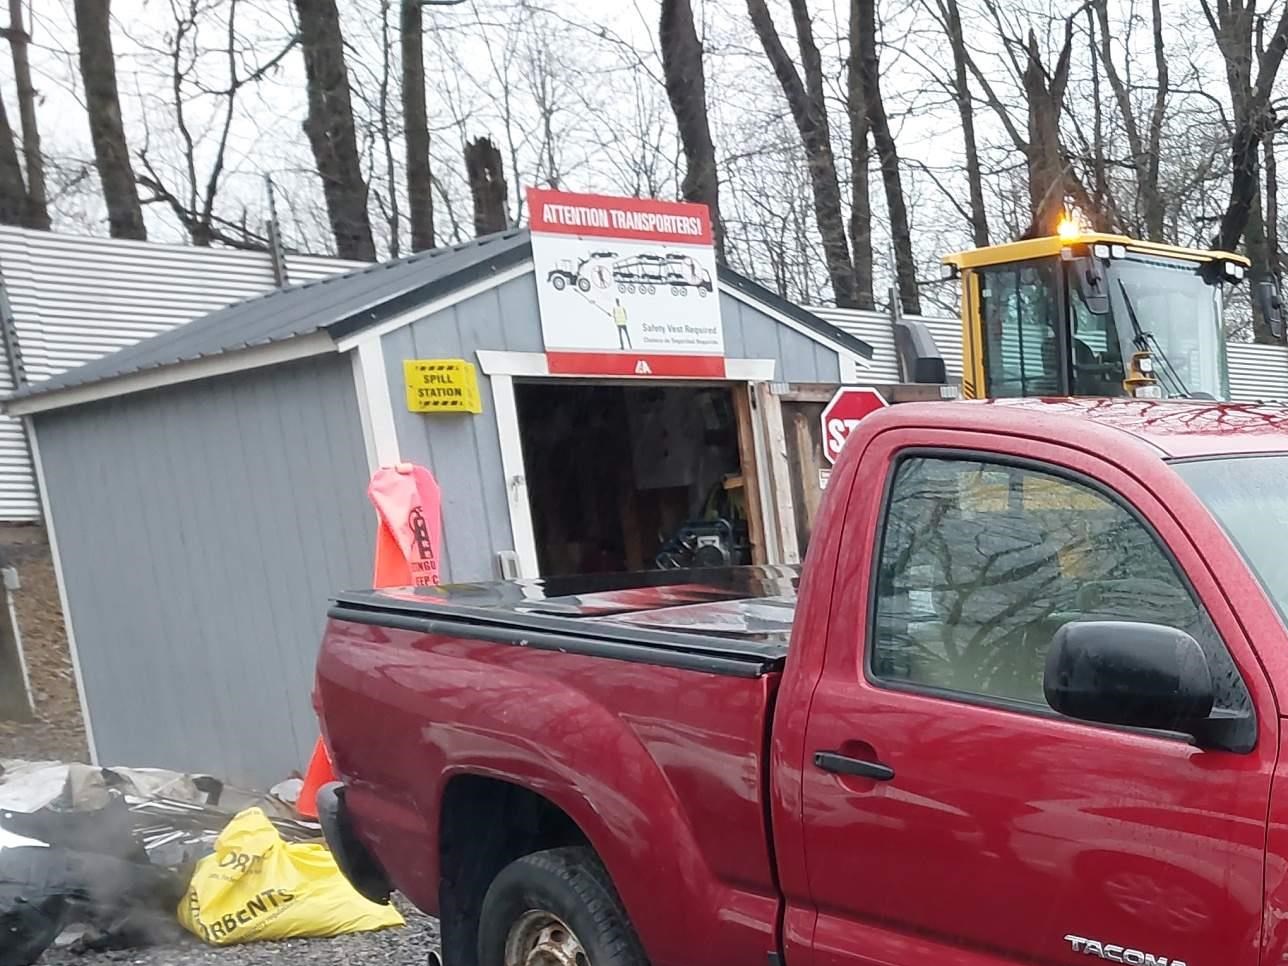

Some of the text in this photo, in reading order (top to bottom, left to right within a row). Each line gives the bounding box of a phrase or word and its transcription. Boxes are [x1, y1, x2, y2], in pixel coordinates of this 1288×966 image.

[543, 203, 703, 236] ATTENTION TRANSPORTERS!
[642, 323, 665, 334] Safety
[423, 374, 453, 384] SPILL
[418, 387, 462, 398] STATION
